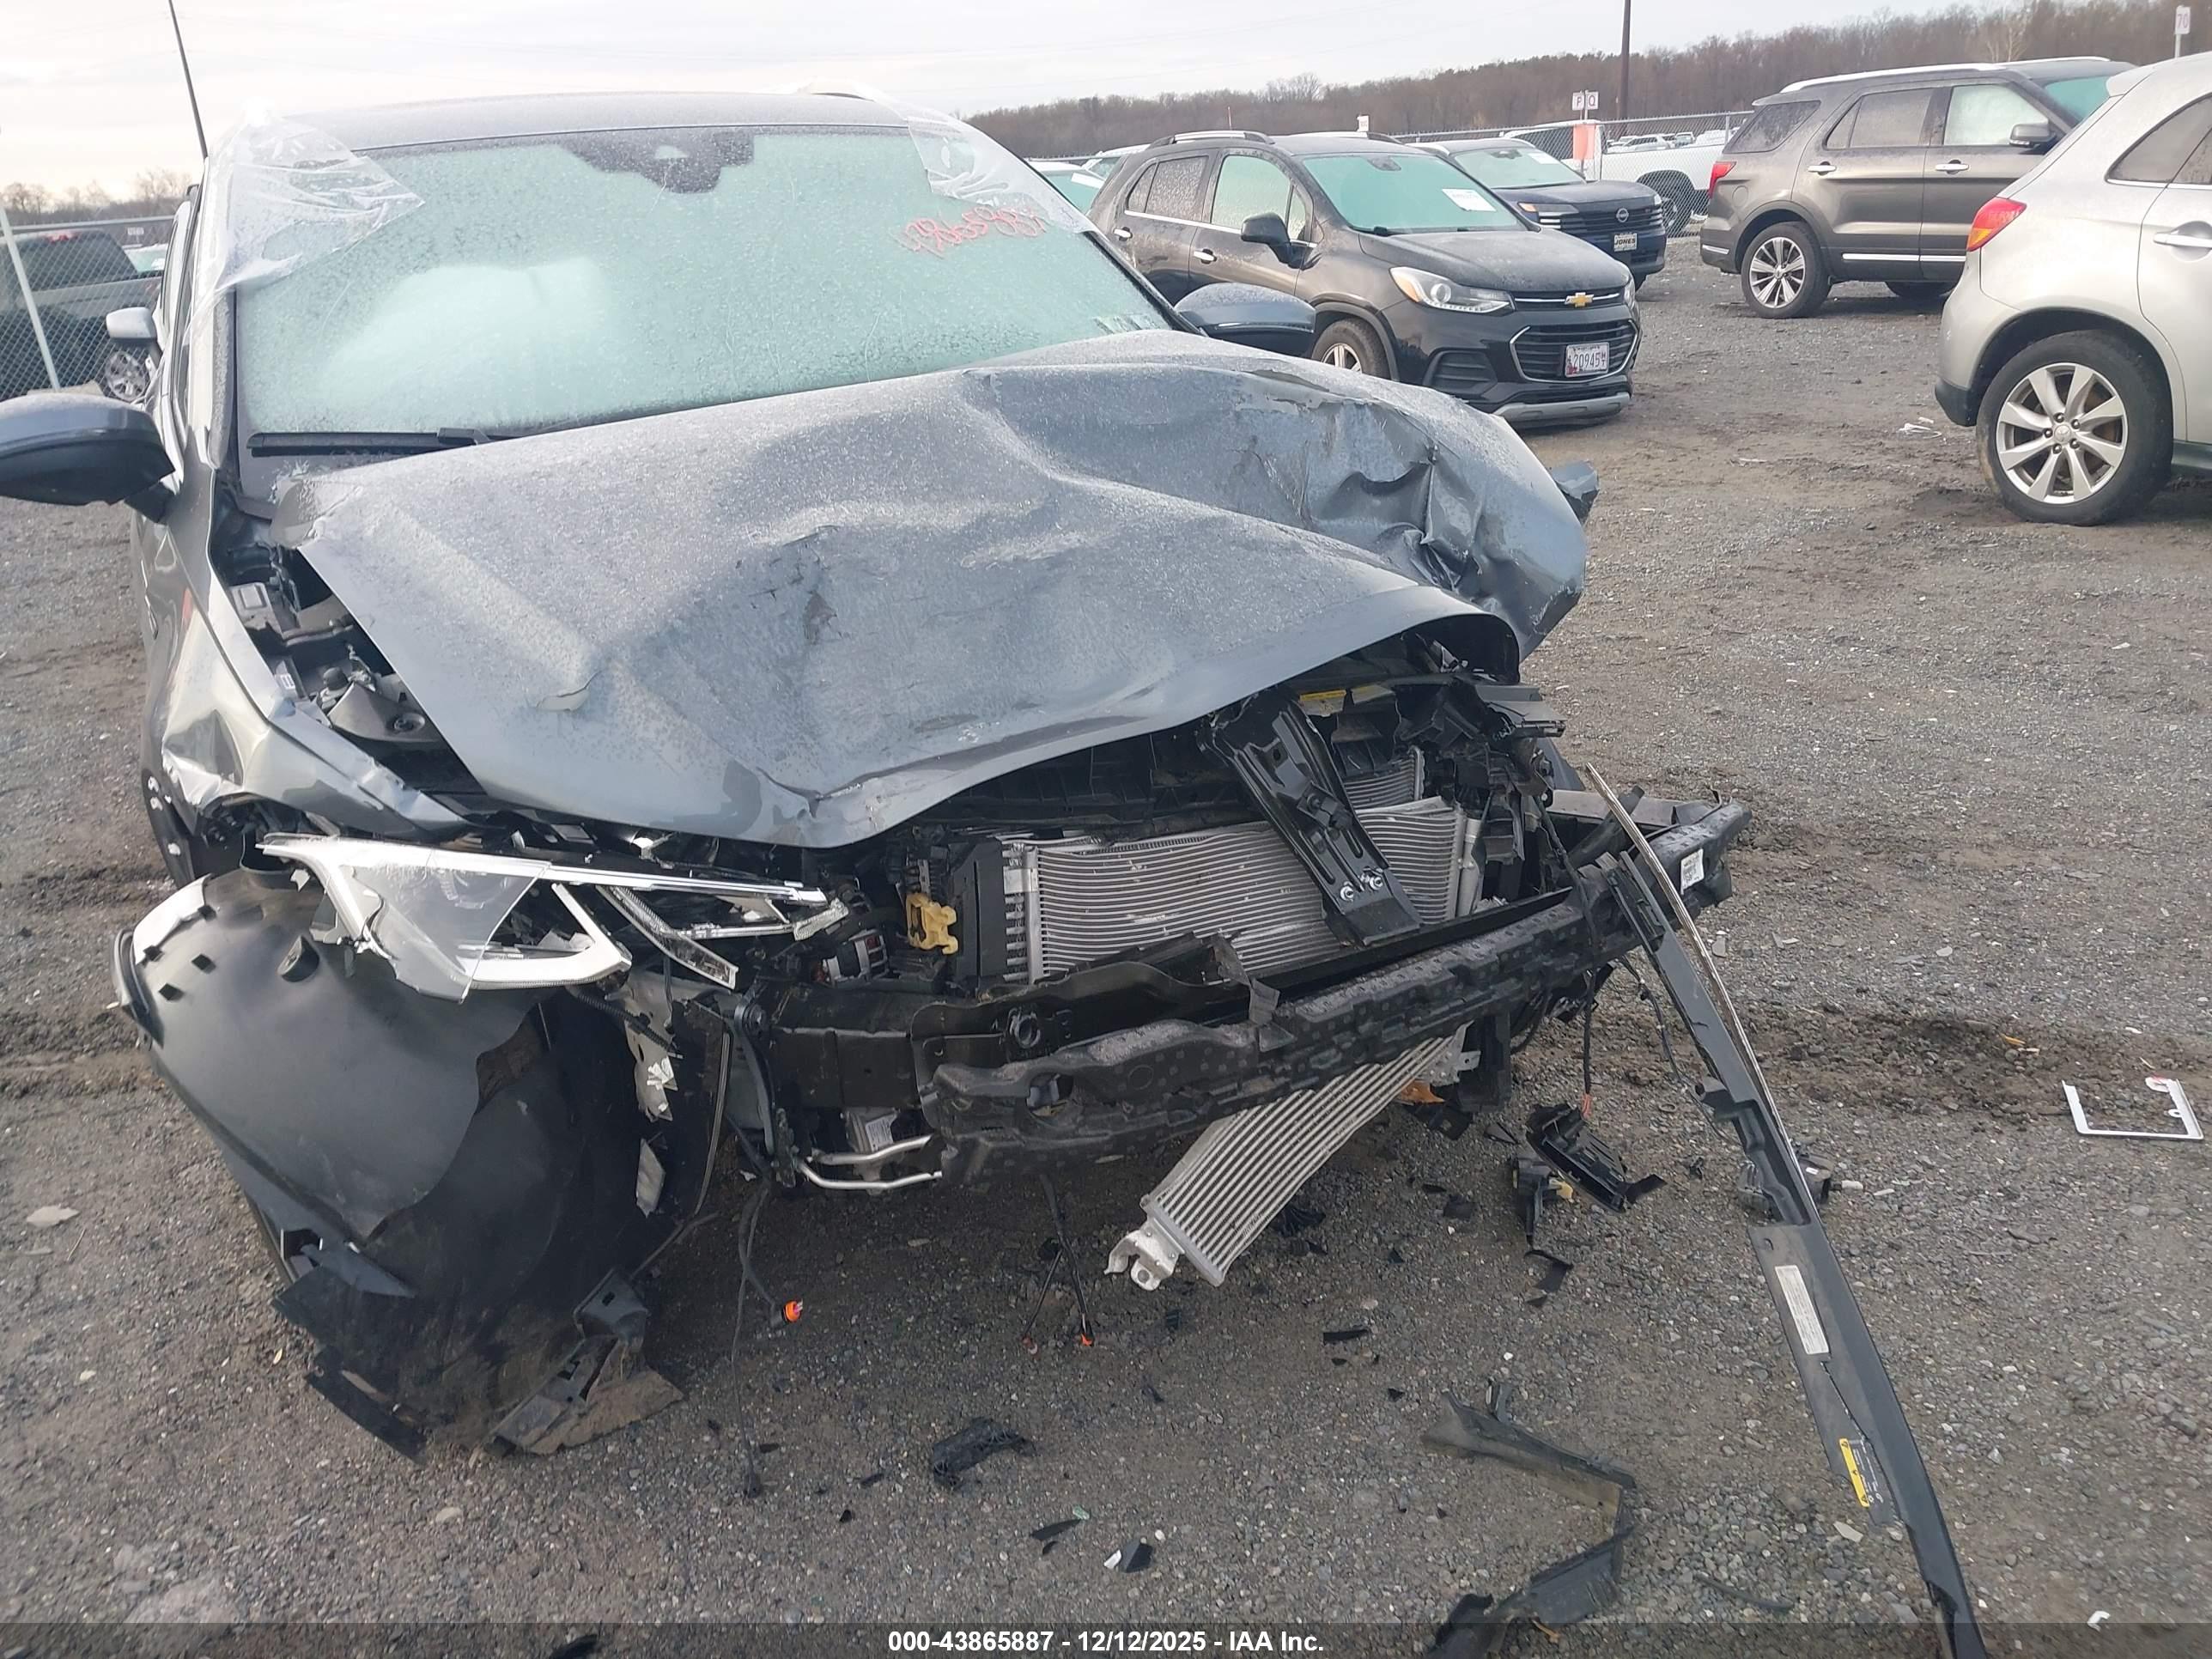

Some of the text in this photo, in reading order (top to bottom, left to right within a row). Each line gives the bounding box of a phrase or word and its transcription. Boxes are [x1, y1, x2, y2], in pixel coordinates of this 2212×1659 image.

[2177, 13, 2189, 28] 70
[1577, 96, 1583, 107] P
[1589, 95, 1595, 106] Q
